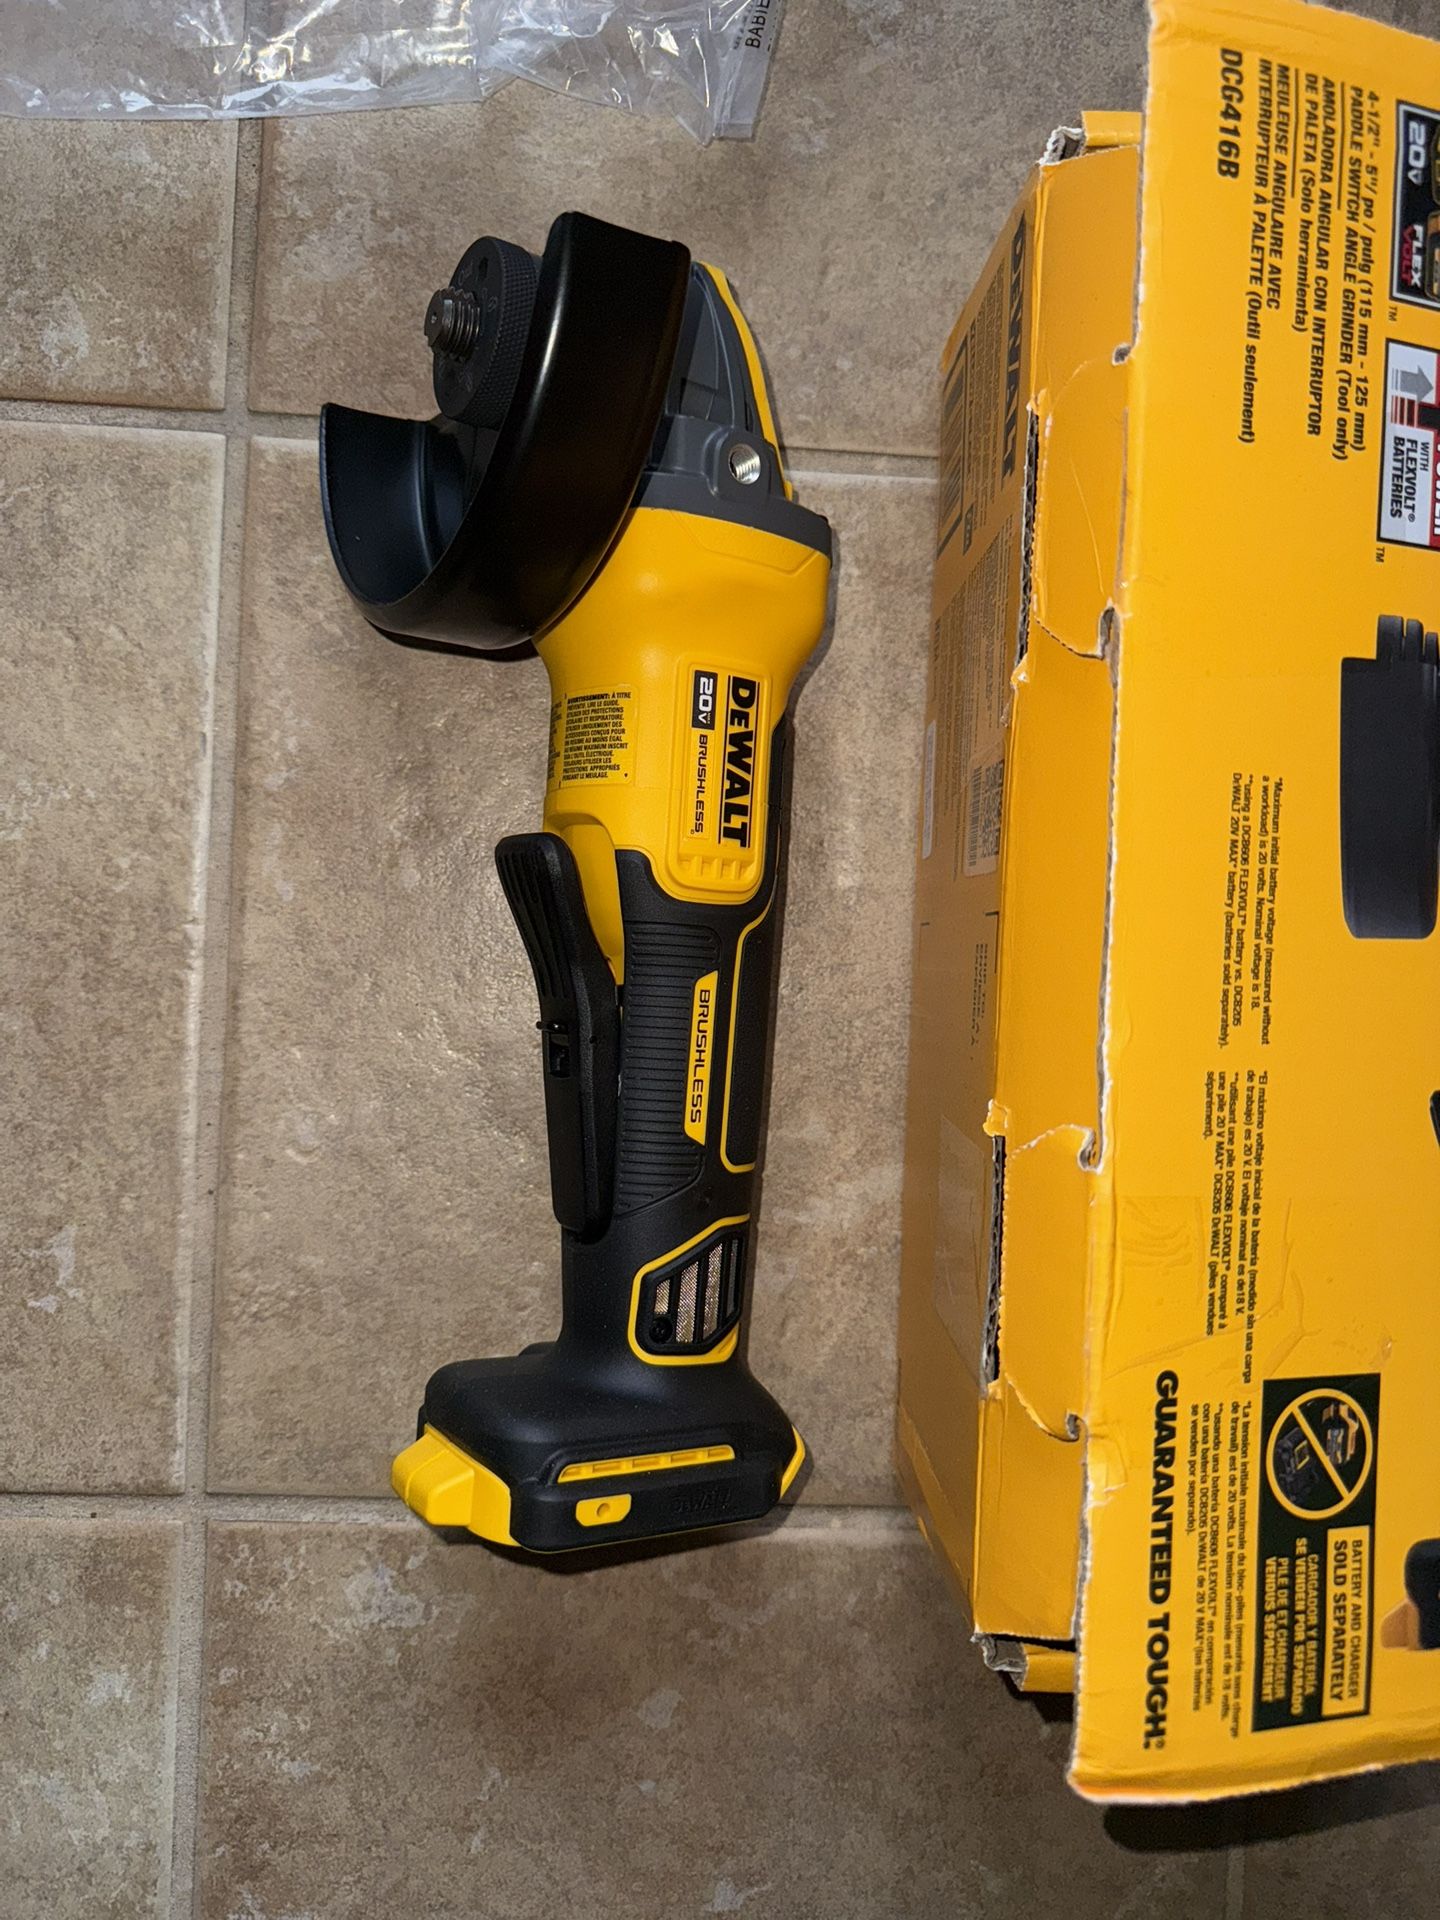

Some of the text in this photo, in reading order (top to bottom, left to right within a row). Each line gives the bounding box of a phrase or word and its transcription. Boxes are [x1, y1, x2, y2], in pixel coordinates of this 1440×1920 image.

[1218, 48, 1243, 179] DCG416B
[1255, 59, 1272, 186] INTERRUPTEUR
[1266, 64, 1289, 309] MEULEUSE ANGULAIRE AVEC
[1292, 73, 1318, 331] DE PALETA (Solo herramienta)
[1360, 196, 1373, 218] po
[1249, 211, 1266, 285] PALETTE
[1307, 78, 1335, 434] AMOLADORA ANGULAR CON INTERRUPTOR
[1332, 86, 1363, 460] PADDLE SWITCH ANGLE GRINDER (Tool only)
[1356, 235, 1373, 273] pulg
[1246, 291, 1261, 339] (Outil
[1357, 279, 1372, 317] (115
[1357, 323, 1368, 355] mm
[1238, 345, 1256, 442] seulement)
[1350, 411, 1365, 450] mm)
[1354, 376, 1368, 406] 125
[1390, 436, 1403, 518] BATTERIES
[1403, 438, 1417, 522] FLEXVOLT®
[1420, 442, 1429, 472] WITH
[1376, 547, 1384, 562] TM
[695, 734, 708, 832] BRUSHLESS
[722, 676, 756, 848] DEWALT
[691, 989, 710, 1123] BRUSHLESS
[1149, 1370, 1179, 1604] GUARANTEED
[1330, 1540, 1347, 1699] SOLD SEPARATELY
[1348, 1539, 1362, 1697] BATTERY AND CHARGER
